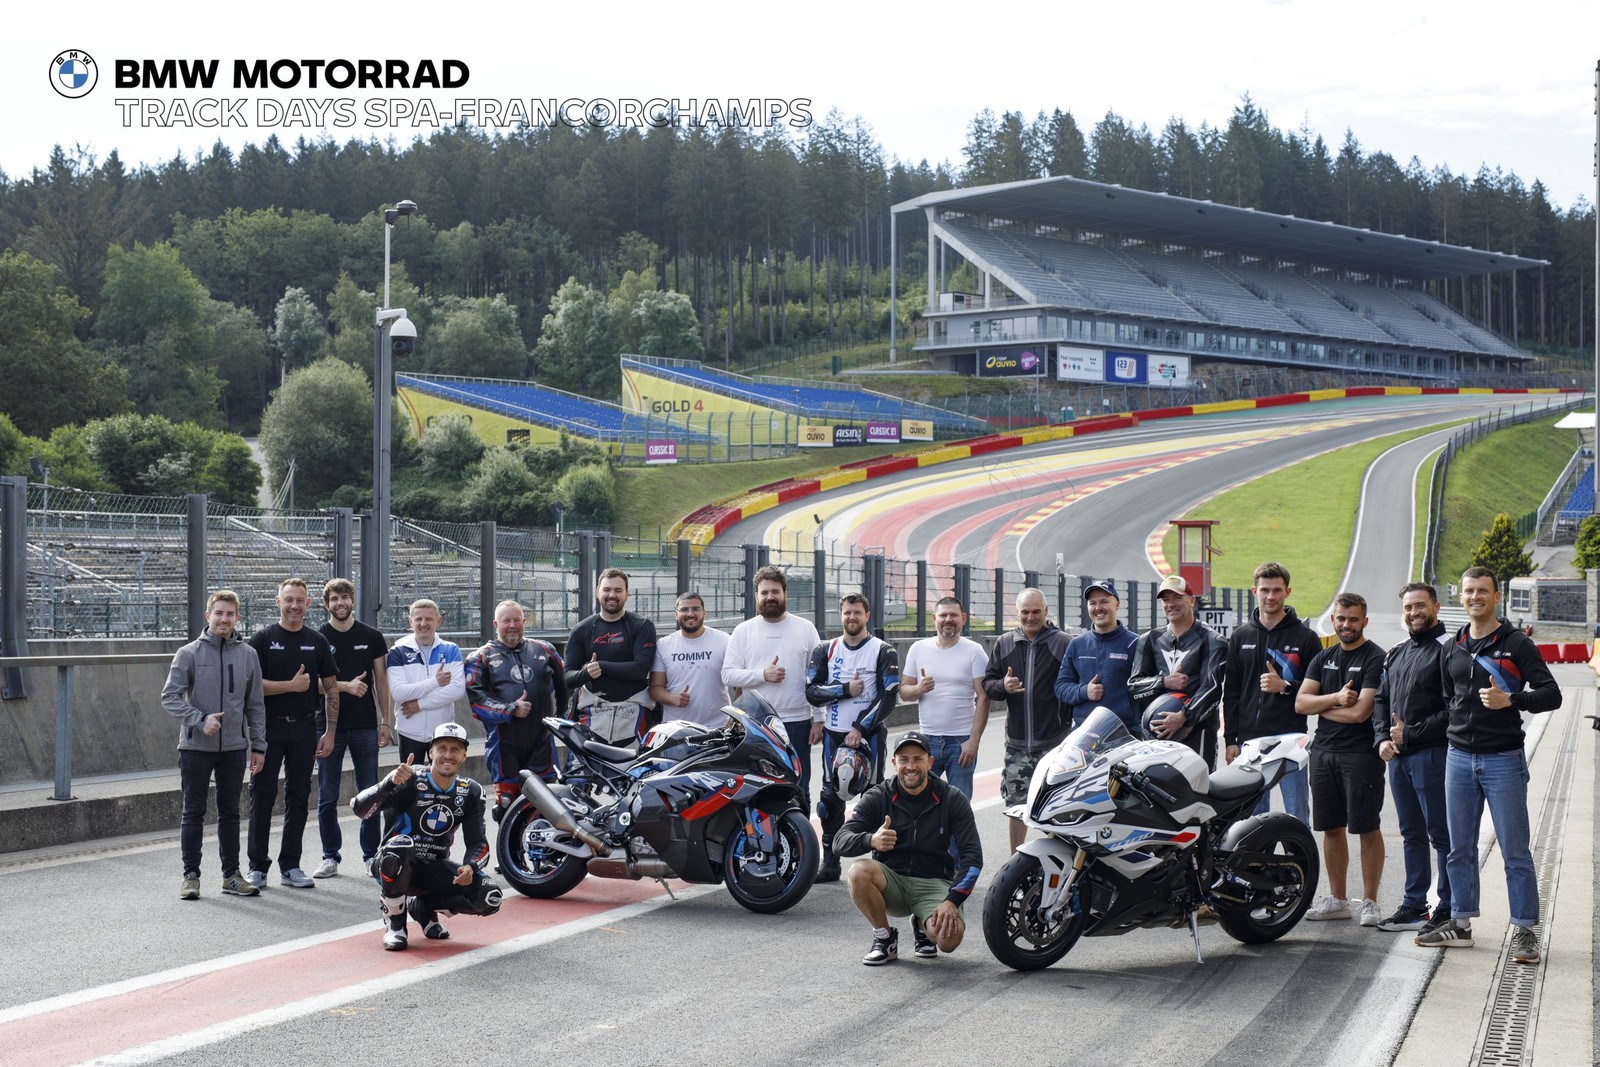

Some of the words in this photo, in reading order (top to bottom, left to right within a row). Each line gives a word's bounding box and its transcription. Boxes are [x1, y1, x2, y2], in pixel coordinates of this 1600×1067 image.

[1117, 360, 1128, 369] 123
[652, 400, 691, 413] GOLD
[693, 399, 704, 412] 4
[835, 428, 858, 438] AISIN
[870, 426, 890, 436] CLASSIC
[1206, 611, 1225, 625] PIT
[671, 651, 713, 662] TOMMY
[832, 656, 844, 680] AYS
[831, 702, 839, 728] TRA
